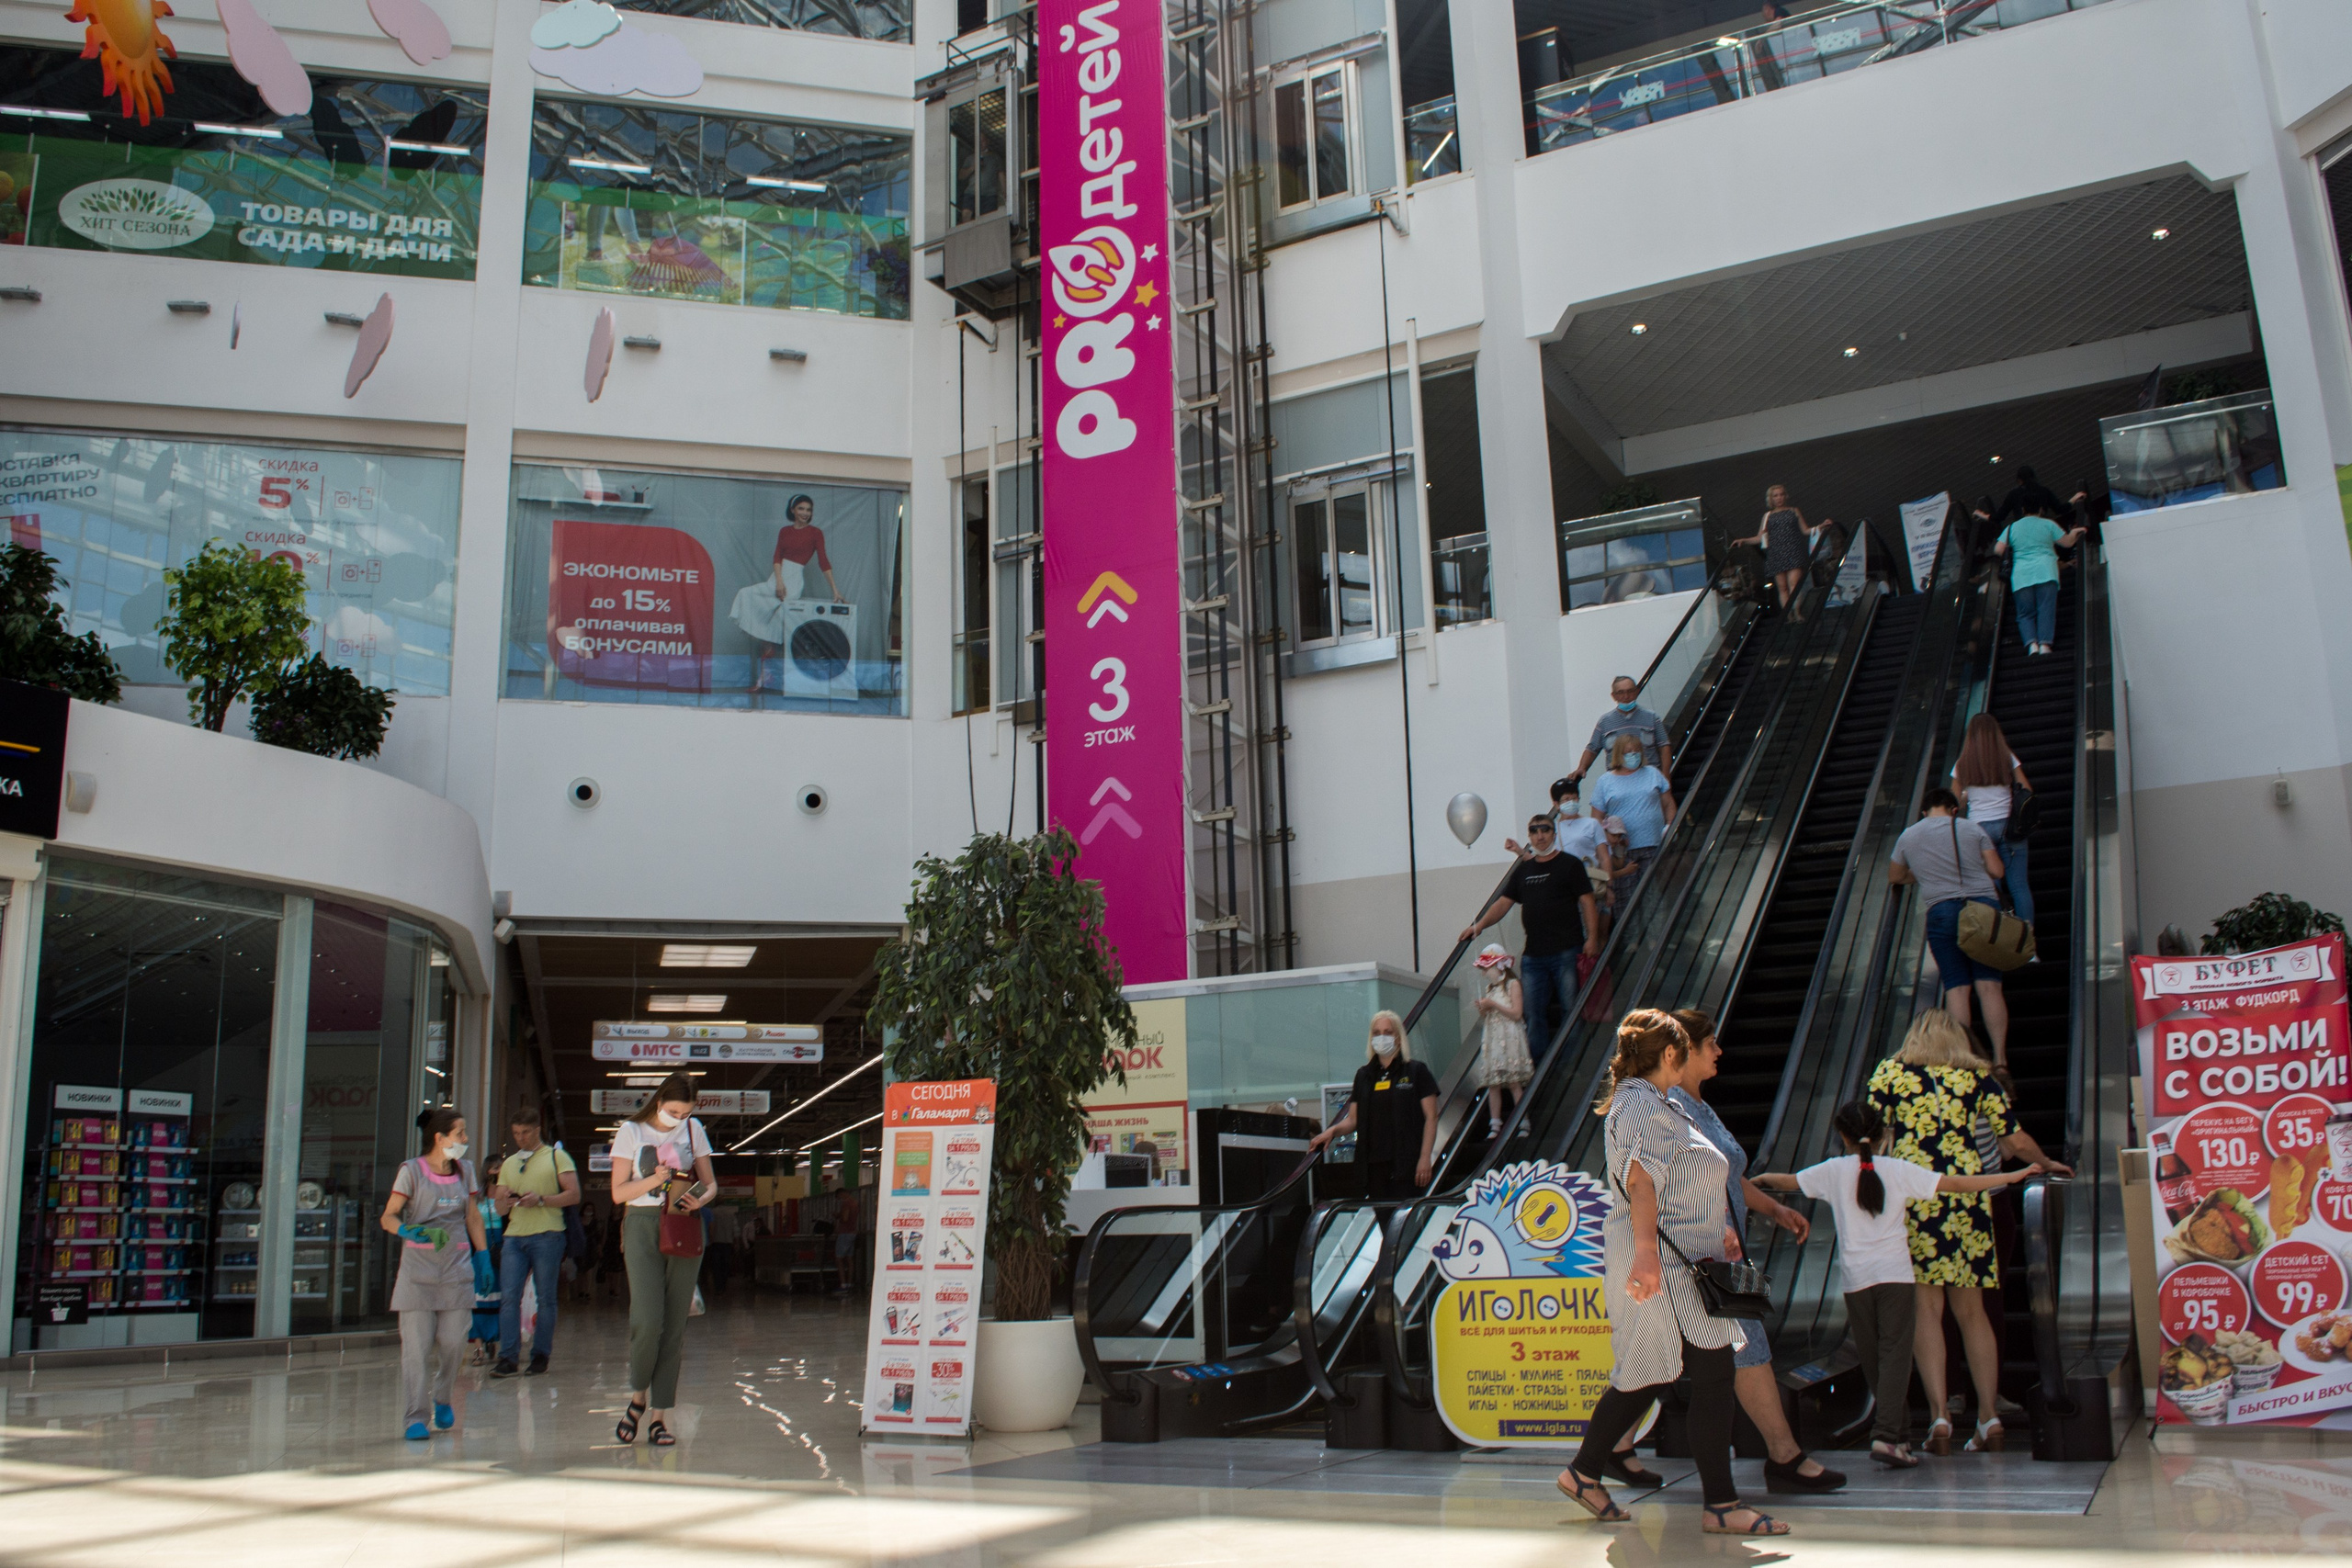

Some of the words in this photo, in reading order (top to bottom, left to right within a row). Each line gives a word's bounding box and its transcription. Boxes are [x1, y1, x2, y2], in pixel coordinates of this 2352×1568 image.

[80, 216, 118, 231] ХИТ
[122, 220, 191, 237] СЕЗОНА
[241, 201, 379, 231] ТОВАРЫ
[384, 215, 453, 238] ДЛЯ
[237, 228, 325, 254] САДА
[334, 235, 355, 254] И
[363, 238, 452, 263] ДАЧИ
[259, 458, 319, 474] скидка
[258, 476, 310, 509] 5%
[245, 531, 307, 546] скидка
[563, 561, 699, 584] ЭКОНОМЬТЕ
[590, 596, 616, 611] до
[621, 590, 671, 613] 15%
[574, 617, 685, 635] оплачивая
[565, 636, 693, 657] БОНУСАМИ
[1088, 657, 1130, 722] 3
[1083, 725, 1136, 748] этаж
[2195, 955, 2278, 982] БУФЕТ
[2181, 1000, 2190, 1011] 3
[2192, 998, 2230, 1011] ЭТАЖ
[2235, 988, 2301, 1009] ФУДКОРД
[2165, 1017, 2328, 1061] ВОЗЬМИ
[643, 1044, 682, 1056] МТС
[2164, 1069, 2190, 1100] С
[2199, 1050, 2348, 1098] СОБОЙ!
[67, 1092, 112, 1104] НОВИНКИ
[910, 1083, 971, 1100] СЕГОДНЯ
[140, 1097, 182, 1108] НОВИНКИ
[891, 1110, 899, 1121] В
[910, 1107, 971, 1122] Галамарт
[1084, 1119, 1114, 1128] НАША
[1114, 1117, 1149, 1127] ЖИЗНЬ
[2190, 1117, 2222, 1128] ПЕРЕКУС
[2223, 1117, 2234, 1126] НА
[2235, 1115, 2255, 1125] БЕГУ
[2264, 1254, 2309, 1268] ДЕТСКИЙ
[2311, 1254, 2329, 1266] СЕТ
[2173, 1275, 2229, 1287] ПЕЛЬМЕШКИ
[2173, 1288, 2179, 1297] В
[2180, 1287, 2232, 1297] КОРОБОЧКЕ
[1458, 1286, 1609, 1322] ИГОЛОЧК
[1460, 1325, 1481, 1337] ВСЁ
[1483, 1325, 1505, 1337] ДЛЯ
[1508, 1325, 1547, 1337] ШИТЬЯ
[1550, 1325, 1557, 1336] И
[1510, 1341, 1525, 1361] 3
[1532, 1348, 1580, 1362] этаж
[1466, 1370, 1507, 1382] СПИЦЫ
[1520, 1369, 1564, 1381] МУЛИНЕ
[1467, 1382, 1515, 1396] ПАЙЕТКИ
[1523, 1384, 1567, 1395] СТРАЗЫ
[1468, 1398, 1498, 1411] ИГЛЫ
[1513, 1397, 1569, 1412] НОЖНИЦЫ
[2237, 1394, 2299, 1416] БЫСТРО
[2303, 1391, 2314, 1403] И
[1514, 1423, 1582, 1434] www.igla.ru
